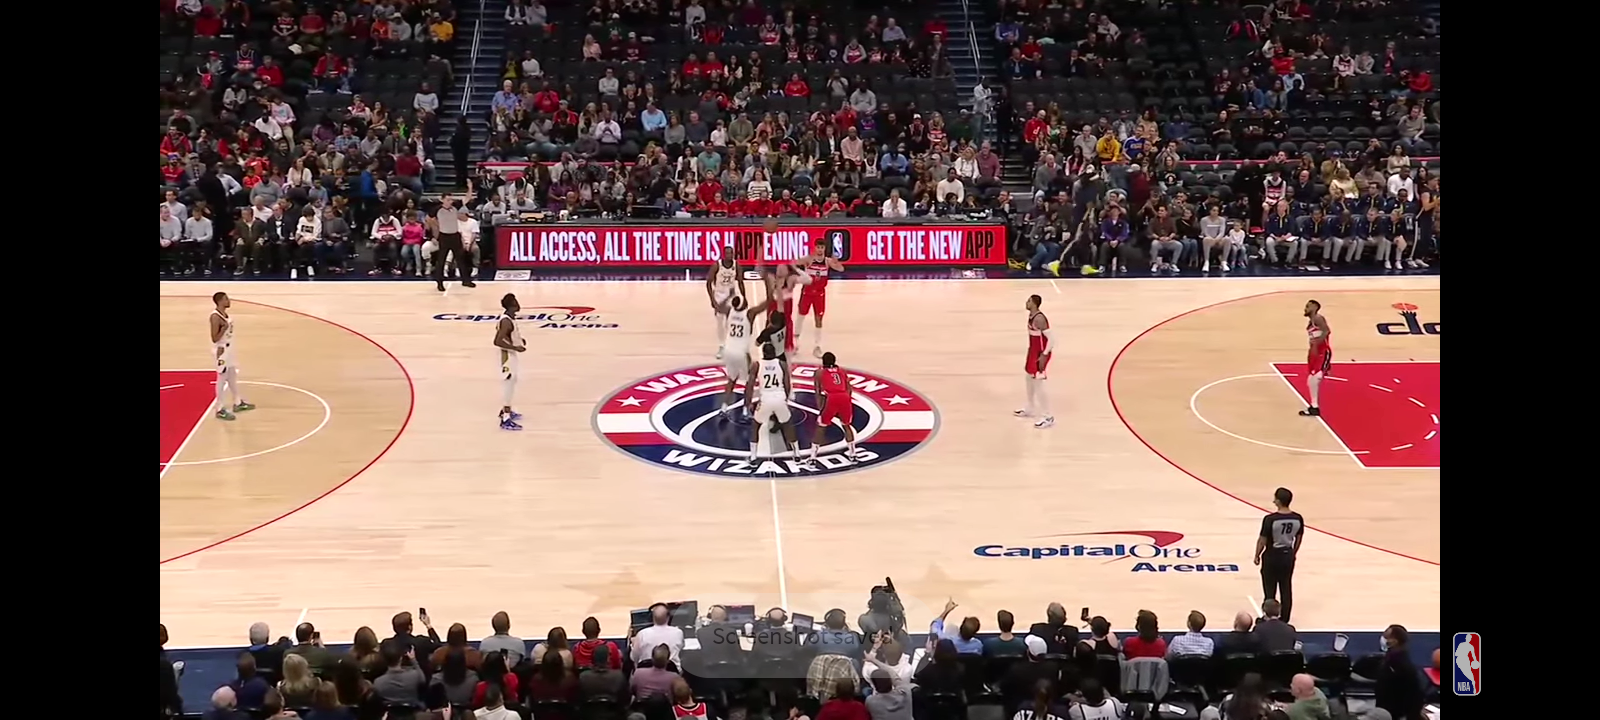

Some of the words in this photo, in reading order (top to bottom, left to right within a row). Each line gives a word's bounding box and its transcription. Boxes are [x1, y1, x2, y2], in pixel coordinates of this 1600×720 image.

[509, 231, 536, 261] ALL
[539, 231, 601, 264] ACCESS,
[604, 231, 630, 261] ALL
[633, 231, 662, 261] THE
[665, 230, 703, 261] TIME
[706, 230, 721, 261] IS
[867, 230, 894, 260] GET
[897, 230, 926, 260] THE
[929, 230, 963, 260] NEW
[965, 230, 995, 260] APP
[433, 313, 549, 322] Capial
[547, 313, 600, 322] One
[730, 323, 744, 338] 33
[763, 373, 780, 389] 24
[831, 372, 841, 385] 3
[1281, 522, 1294, 535] 78
[973, 544, 1125, 559] Capital
[1129, 543, 1201, 559] One
[1131, 562, 1239, 572] Arena
